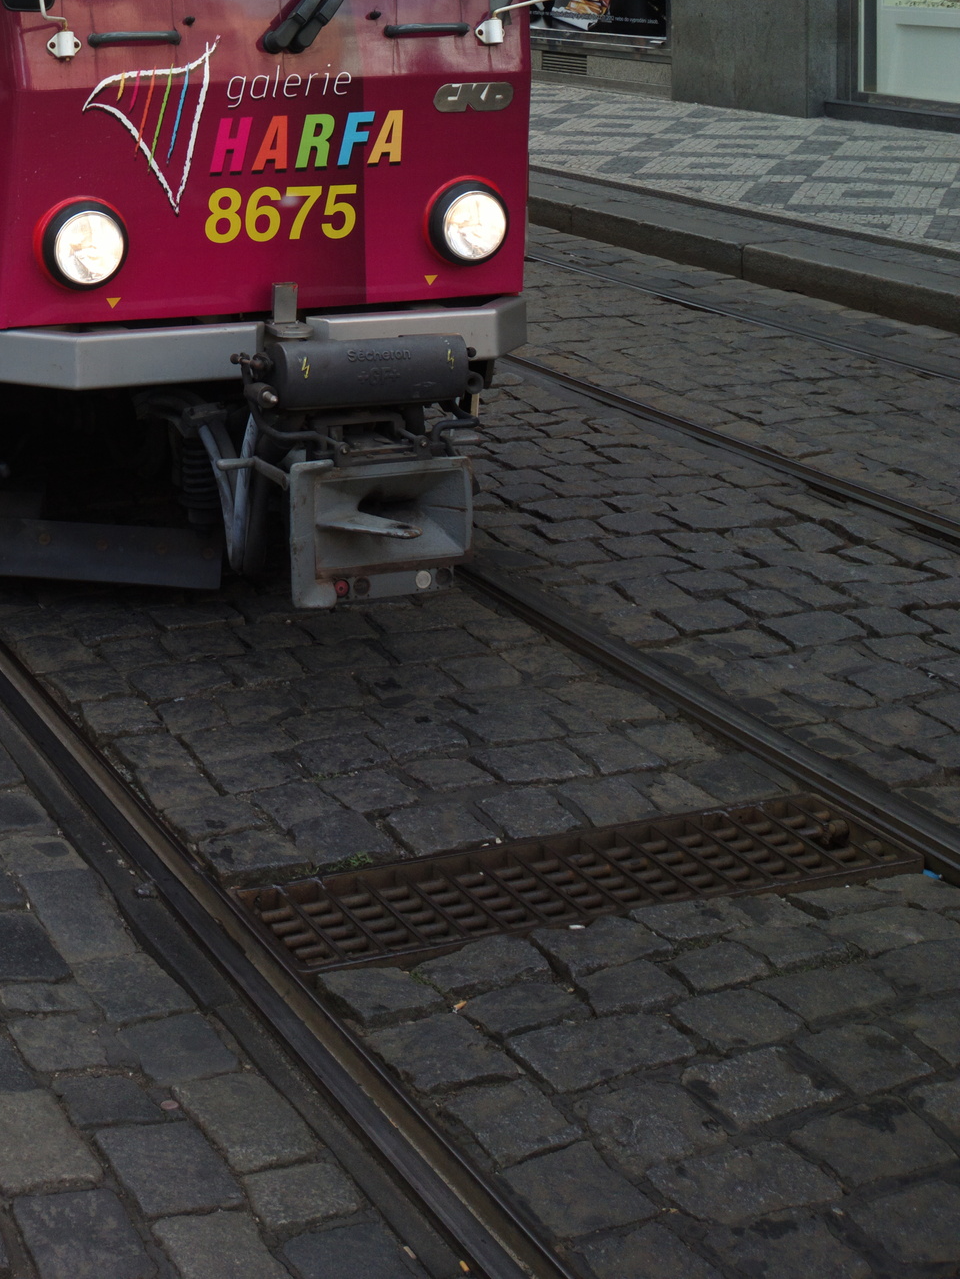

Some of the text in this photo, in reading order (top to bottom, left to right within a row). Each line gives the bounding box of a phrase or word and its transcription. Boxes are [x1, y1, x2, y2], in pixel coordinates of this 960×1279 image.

[226, 64, 352, 109] galerie
[209, 109, 404, 177] HARFA
[204, 184, 357, 244] 8675
